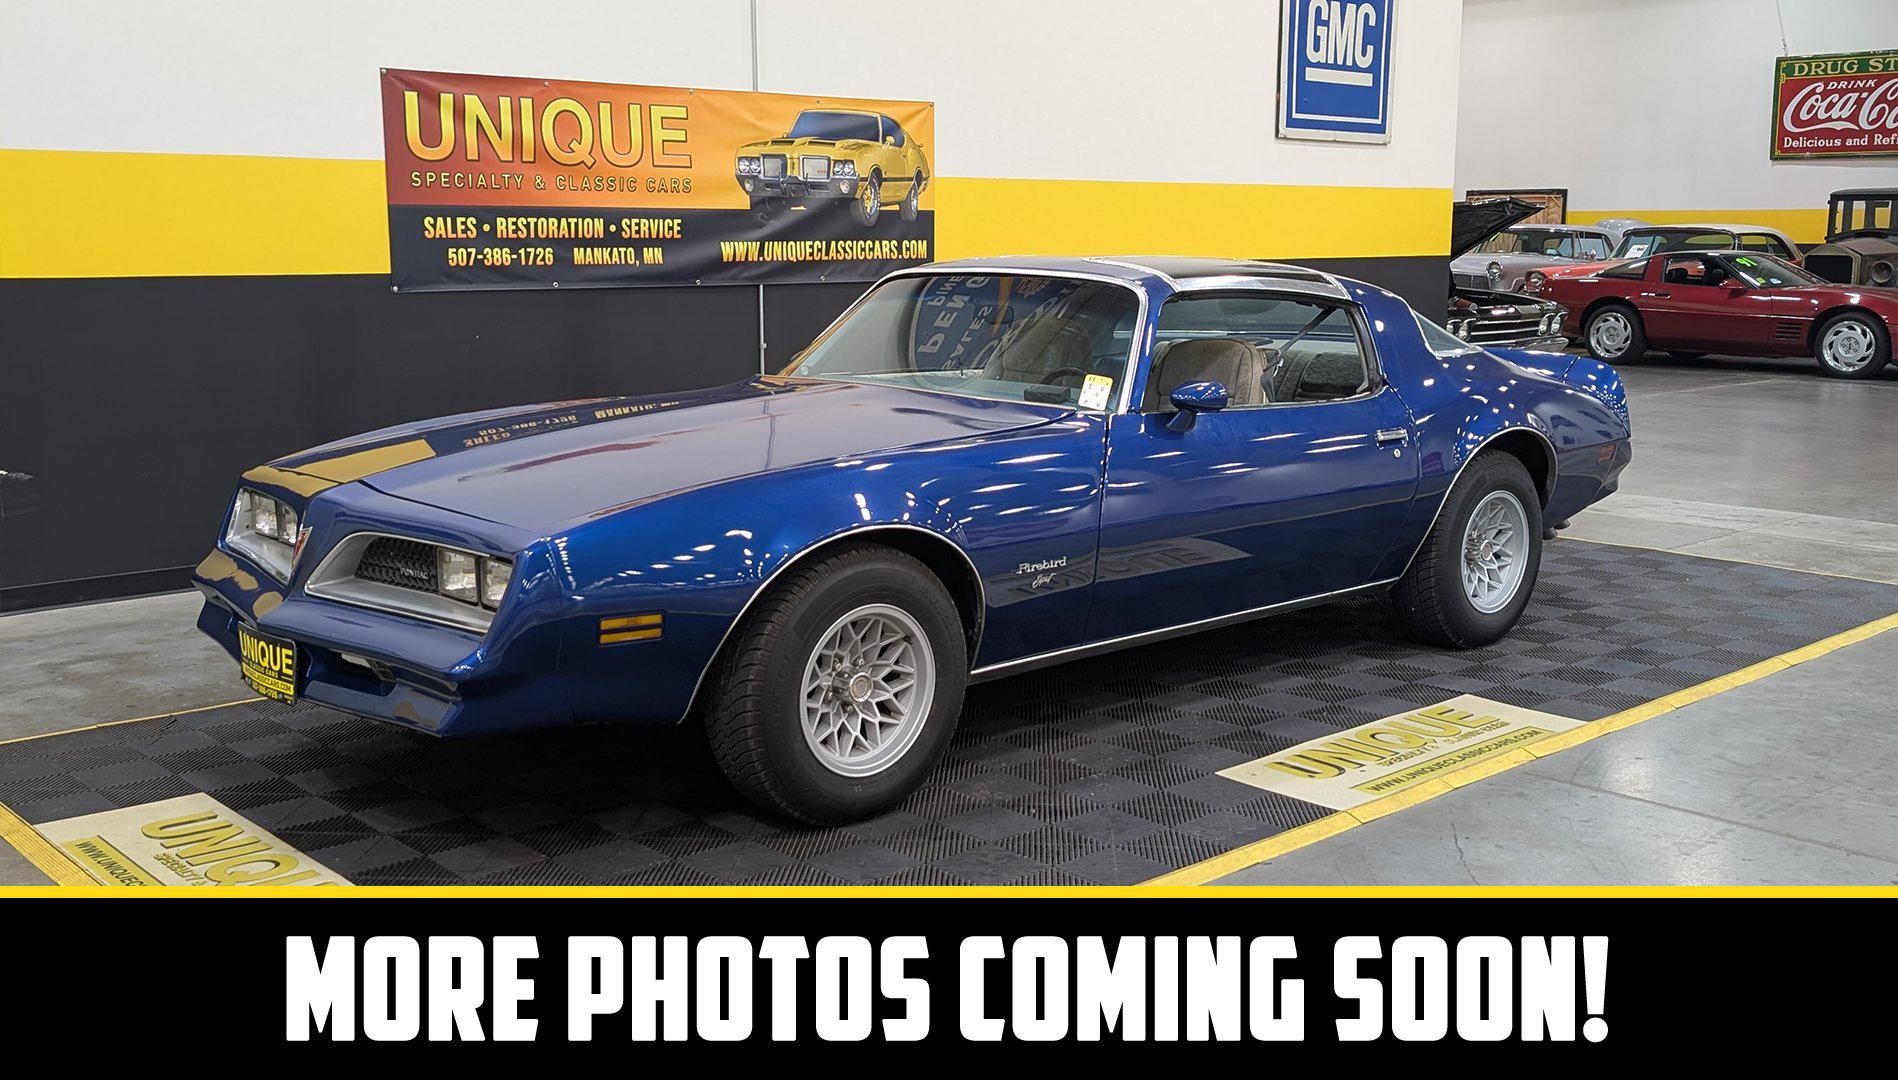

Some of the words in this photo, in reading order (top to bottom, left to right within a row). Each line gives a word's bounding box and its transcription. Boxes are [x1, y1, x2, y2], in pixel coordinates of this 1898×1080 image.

[1306, 0, 1376, 68] GMC
[1793, 60, 1859, 76] DRUG
[1827, 79, 1878, 90] DRINK
[402, 90, 692, 169] UNIQUE
[1783, 136, 1841, 148] Delicious
[1846, 134, 1868, 146] and
[411, 171, 524, 190] SPECIALTY
[534, 174, 546, 190] &
[556, 175, 638, 192] CLASSIC
[646, 178, 693, 193] CARS
[423, 216, 477, 239] SALES
[496, 217, 604, 239] RESTORATION
[621, 219, 682, 239] SERVICE
[448, 247, 554, 267] 507-386-1726
[573, 247, 639, 267] MANKATO,
[643, 247, 663, 264] MN
[720, 239, 928, 262] WWW.UNIQUECLASSICCARS.COM
[1015, 556, 1067, 575] Firebird
[239, 630, 293, 676] UNIQUE
[1266, 705, 1500, 780] UNIQUE
